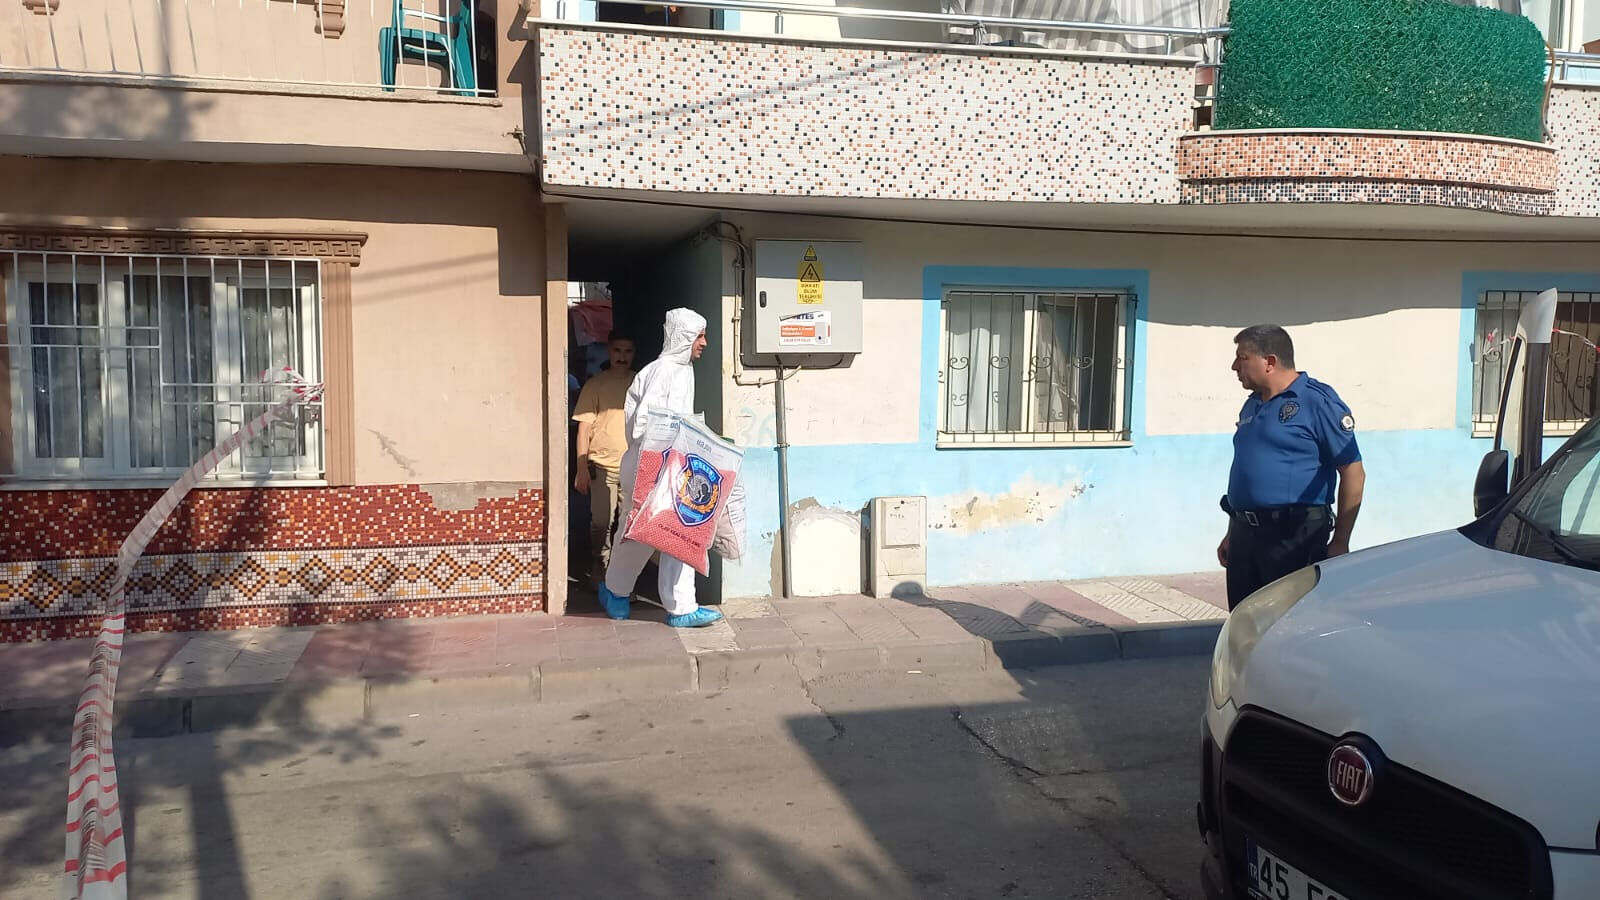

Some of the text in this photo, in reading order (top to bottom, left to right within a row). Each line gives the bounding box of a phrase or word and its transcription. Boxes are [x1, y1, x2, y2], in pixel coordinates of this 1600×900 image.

[1336, 760, 1364, 793] FIAT
[1249, 863, 1258, 881] TR
[1261, 856, 1290, 900] 45
